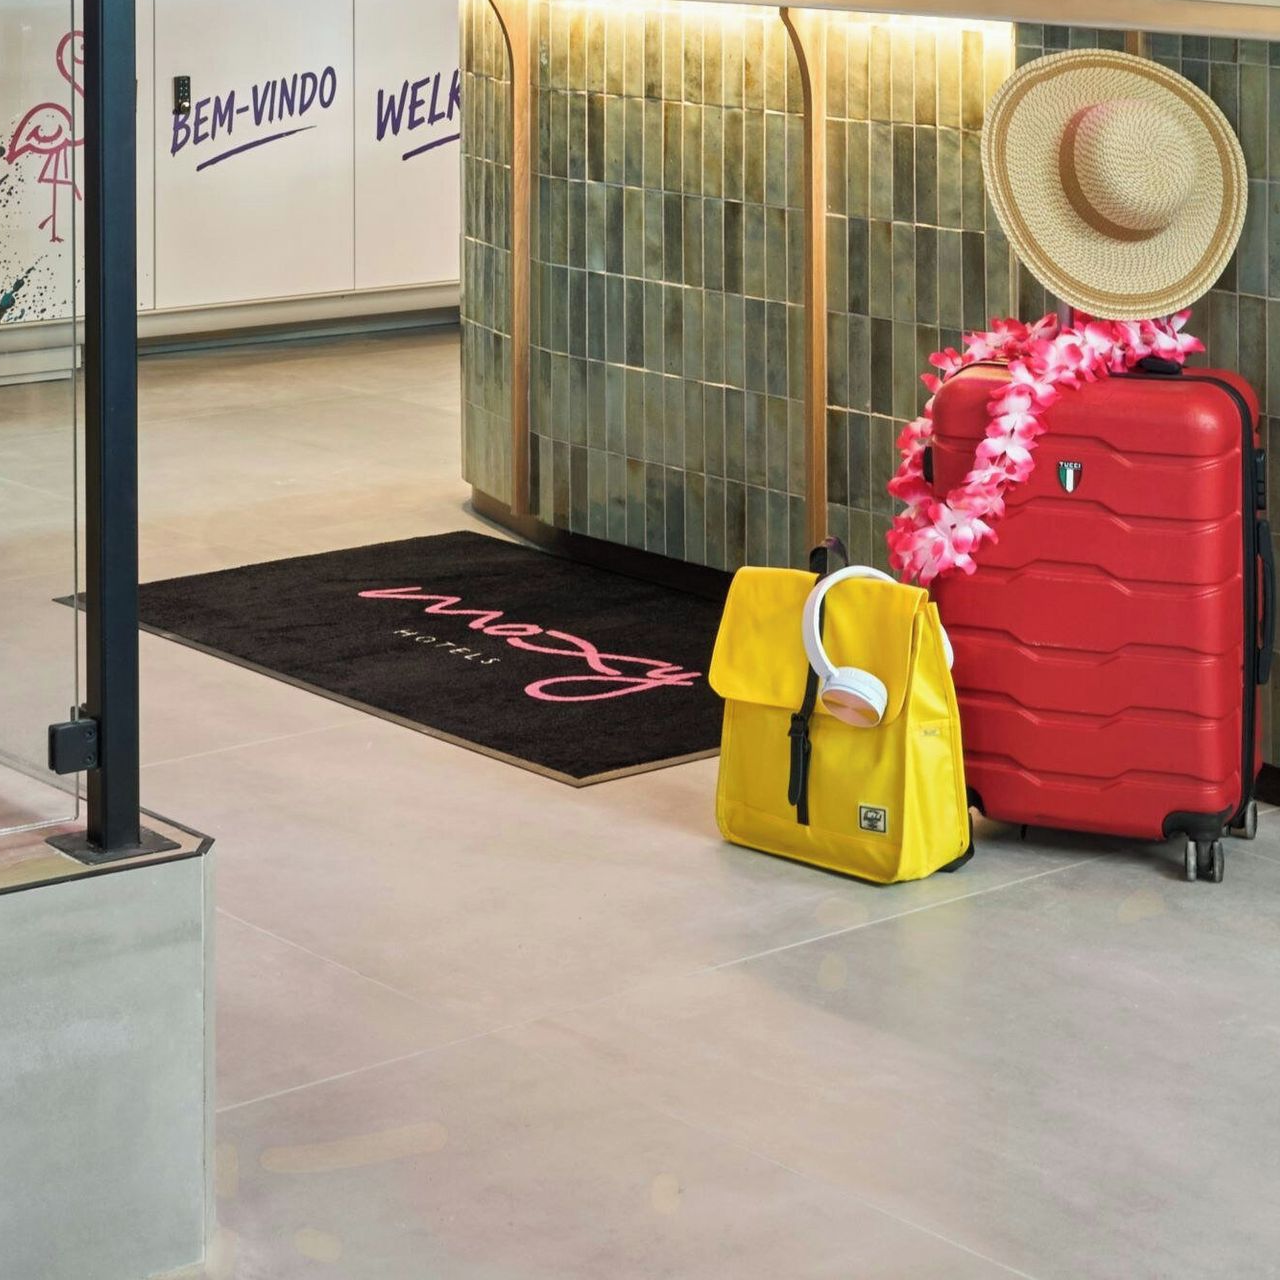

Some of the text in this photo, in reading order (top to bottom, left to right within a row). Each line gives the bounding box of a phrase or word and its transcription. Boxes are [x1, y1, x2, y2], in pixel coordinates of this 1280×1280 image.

[170, 66, 337, 156] BEM-VINDO
[1058, 461, 1081, 469] TUCCI
[393, 629, 501, 665] HOTELS
